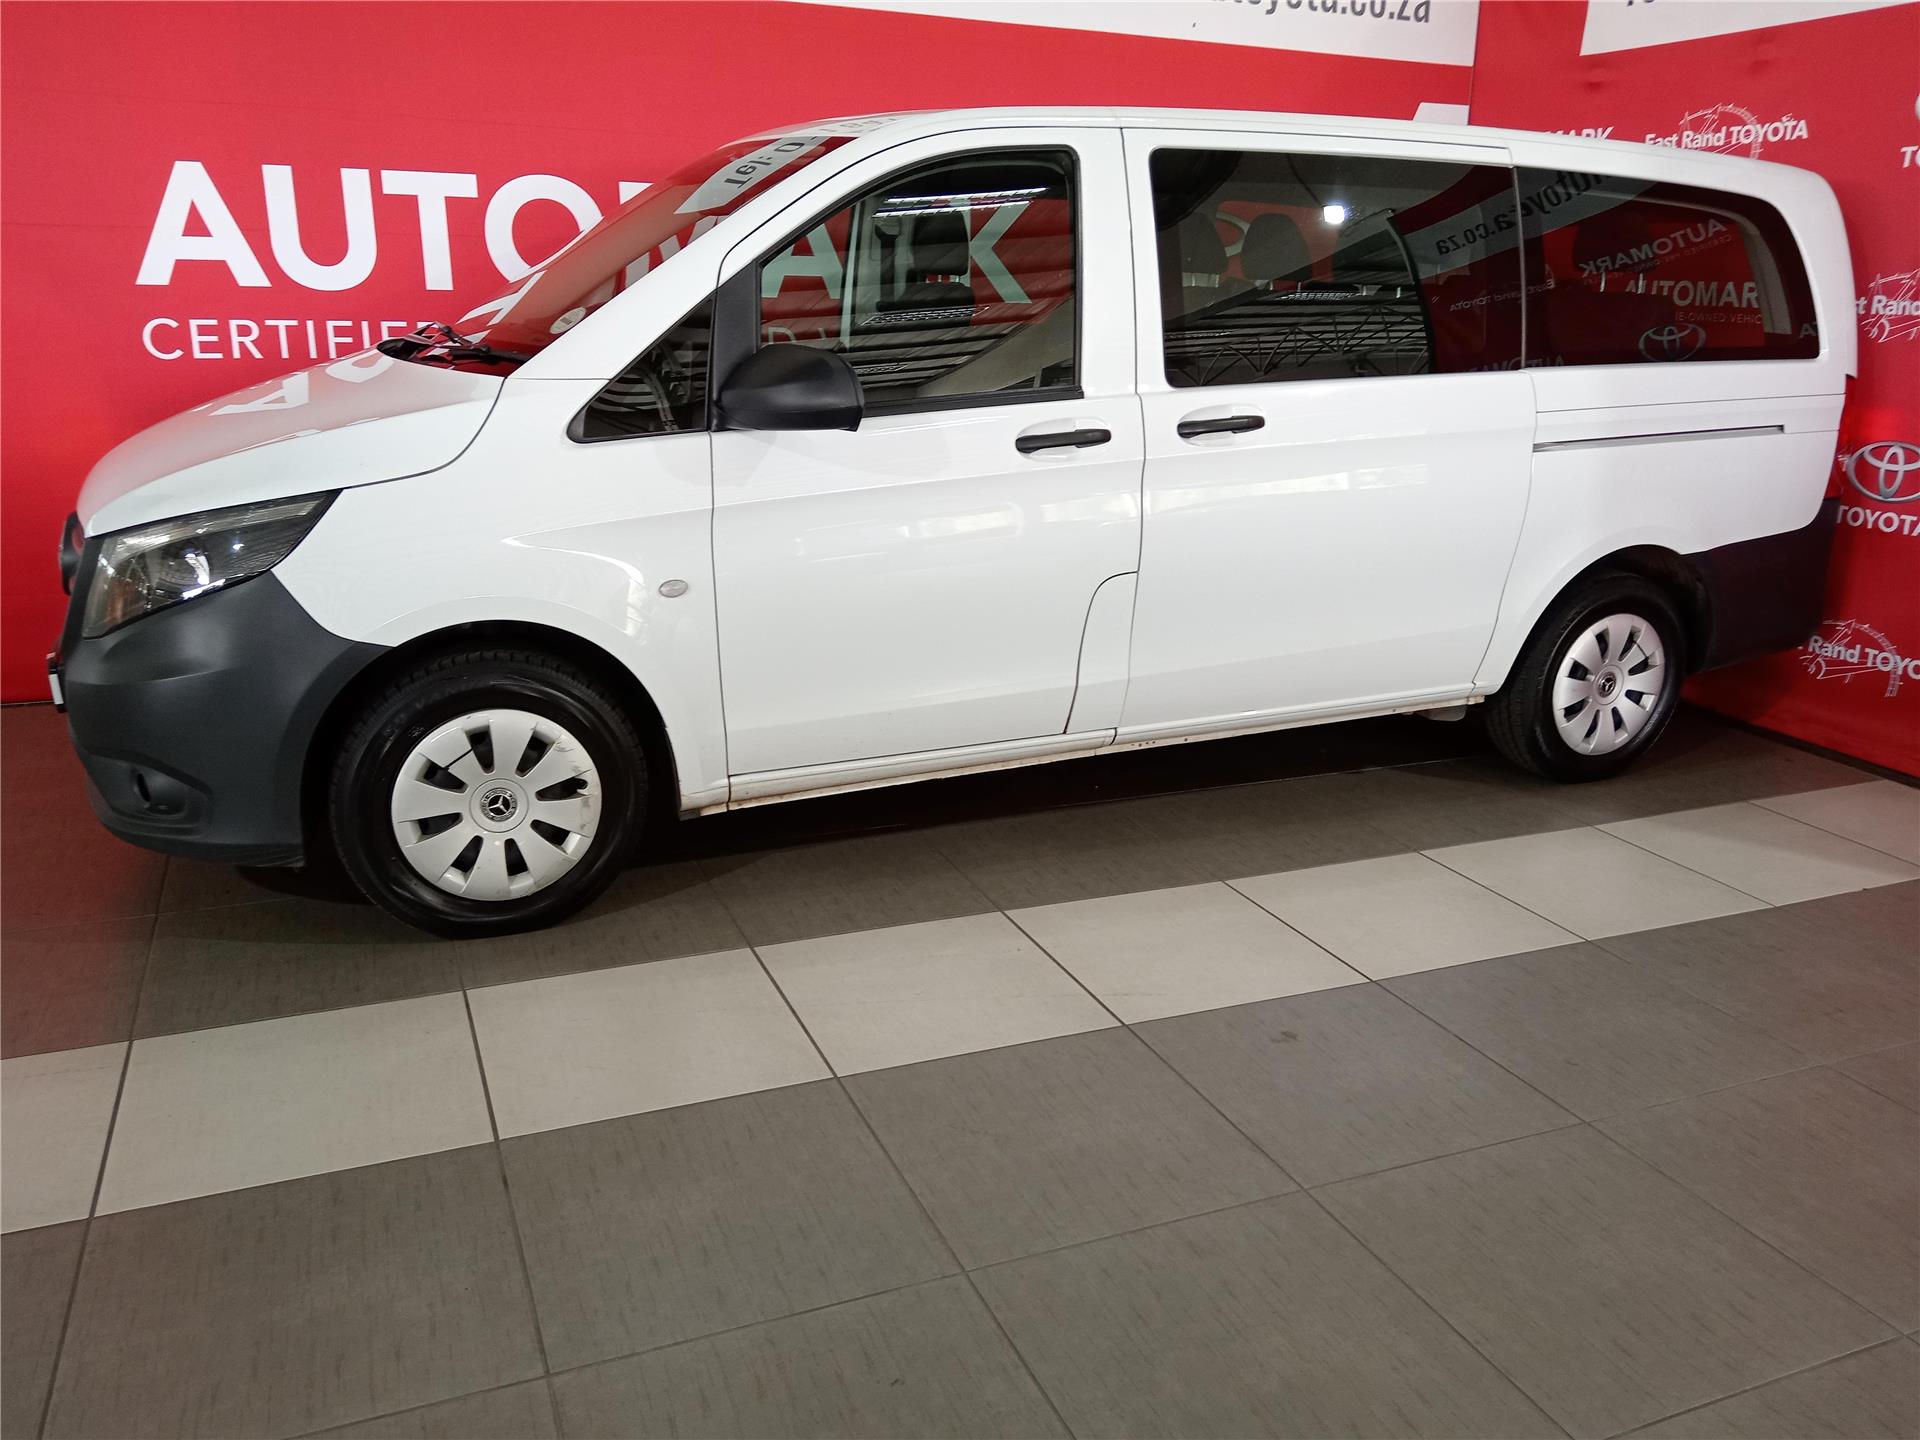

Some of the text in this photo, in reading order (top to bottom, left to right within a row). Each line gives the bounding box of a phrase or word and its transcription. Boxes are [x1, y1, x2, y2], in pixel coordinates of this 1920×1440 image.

[1681, 127, 1725, 150] Rand
[1730, 116, 1809, 146] TOYOTA
[1808, 635, 1861, 664] Rand
